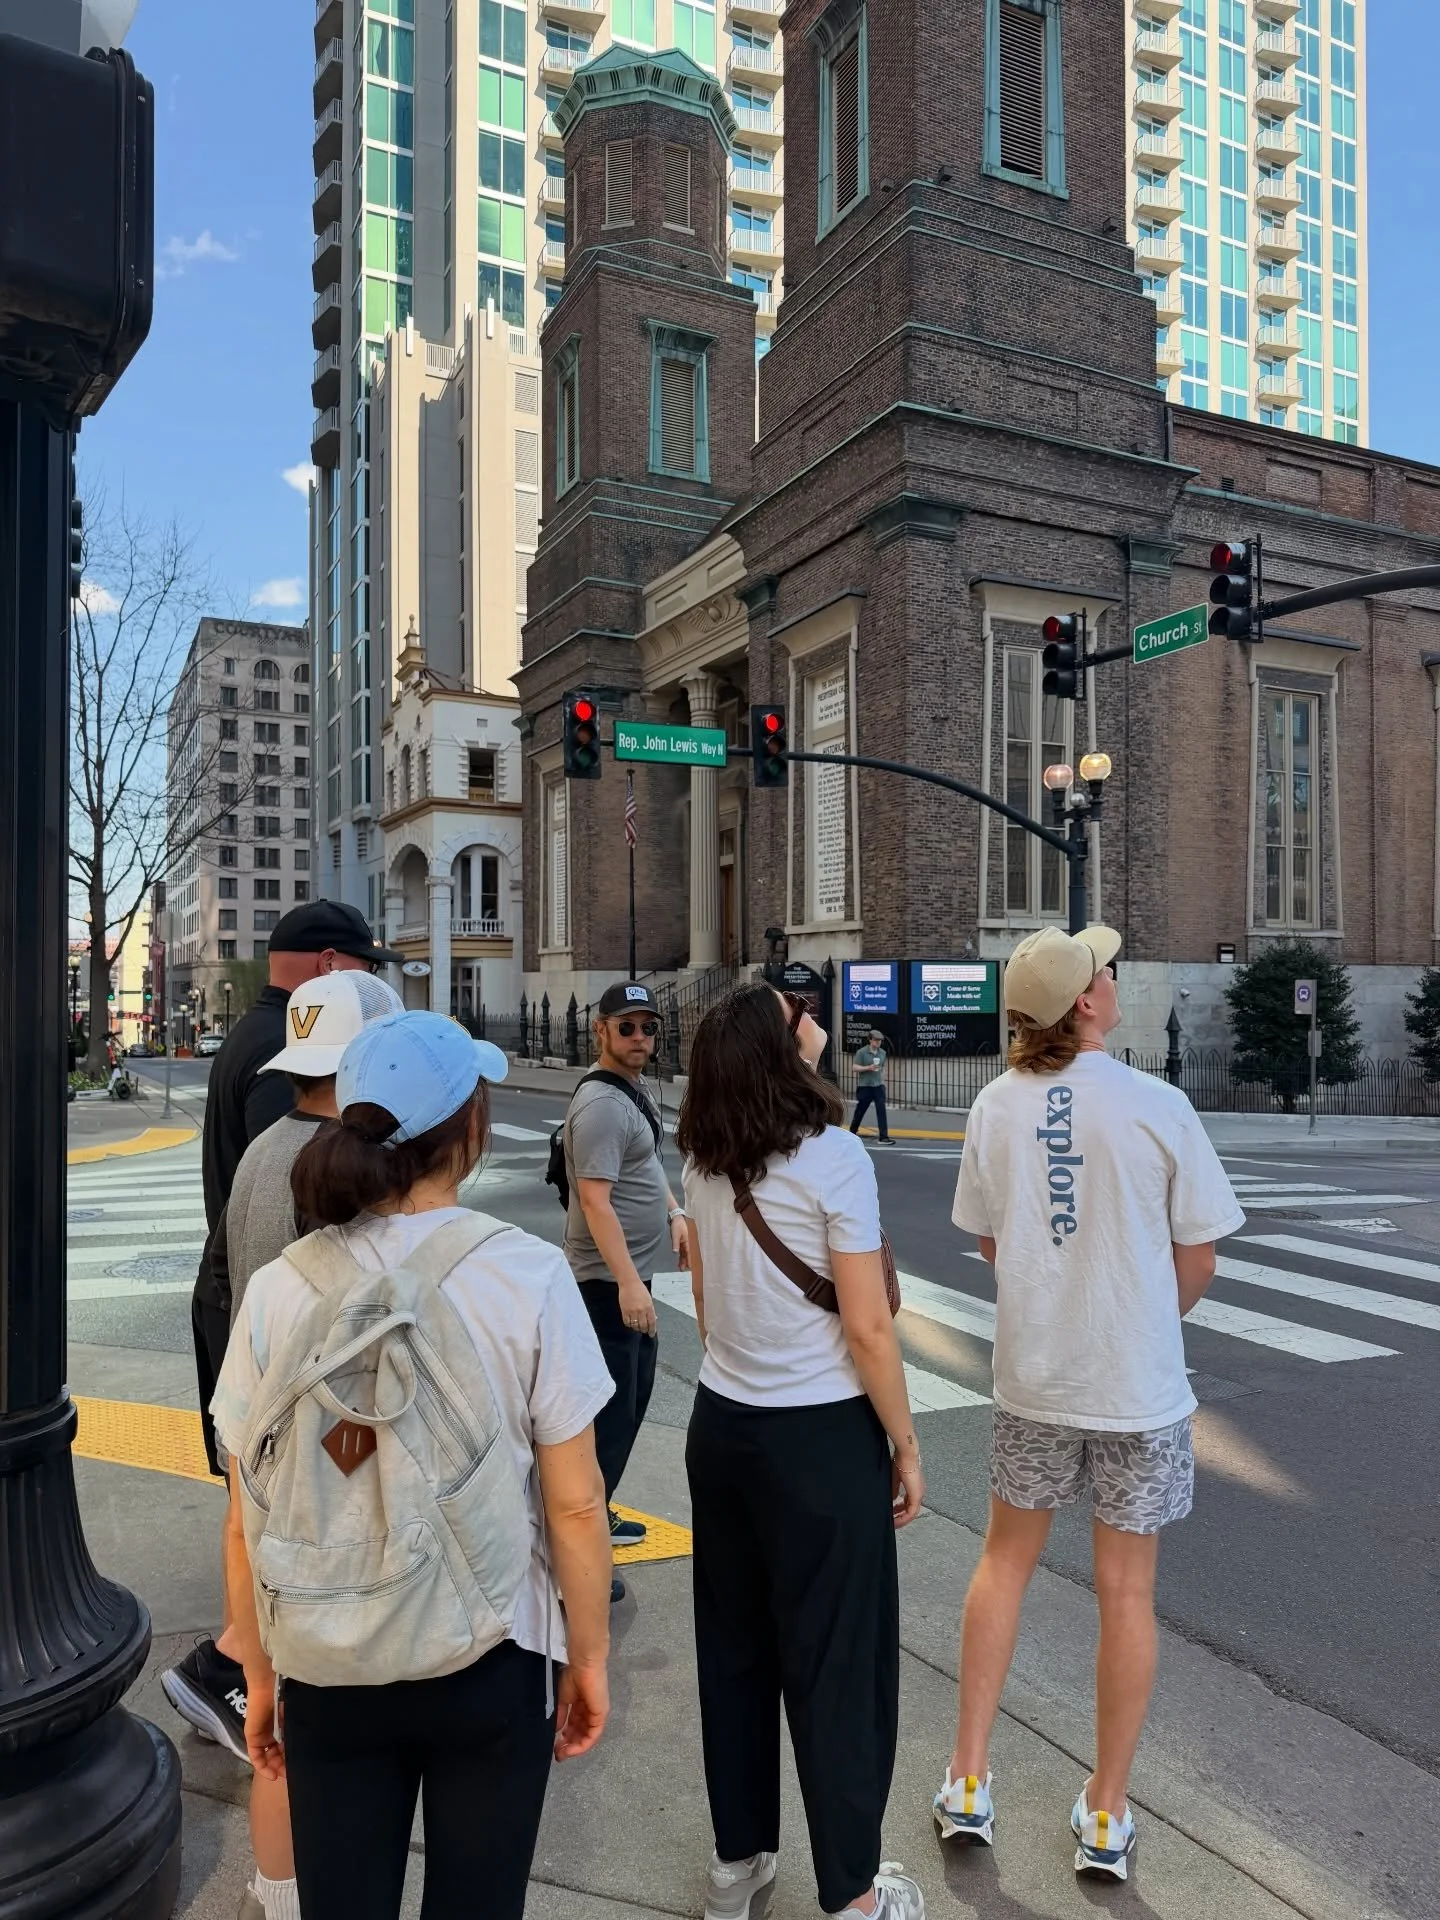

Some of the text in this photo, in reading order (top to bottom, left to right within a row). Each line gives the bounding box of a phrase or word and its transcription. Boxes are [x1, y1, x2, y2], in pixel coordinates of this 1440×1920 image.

[1139, 620, 1202, 651] Church St
[618, 733, 724, 758] Rep. John Lewis Way N
[290, 1005, 324, 1039] V
[916, 1016, 928, 1024] THE
[916, 1024, 957, 1032] DOWNTOWN
[916, 1032, 956, 1040] PRESBYTERIAN
[916, 1040, 942, 1048] CHURCH
[1036, 1085, 1084, 1247] explore.
[224, 1687, 248, 1718] HO
